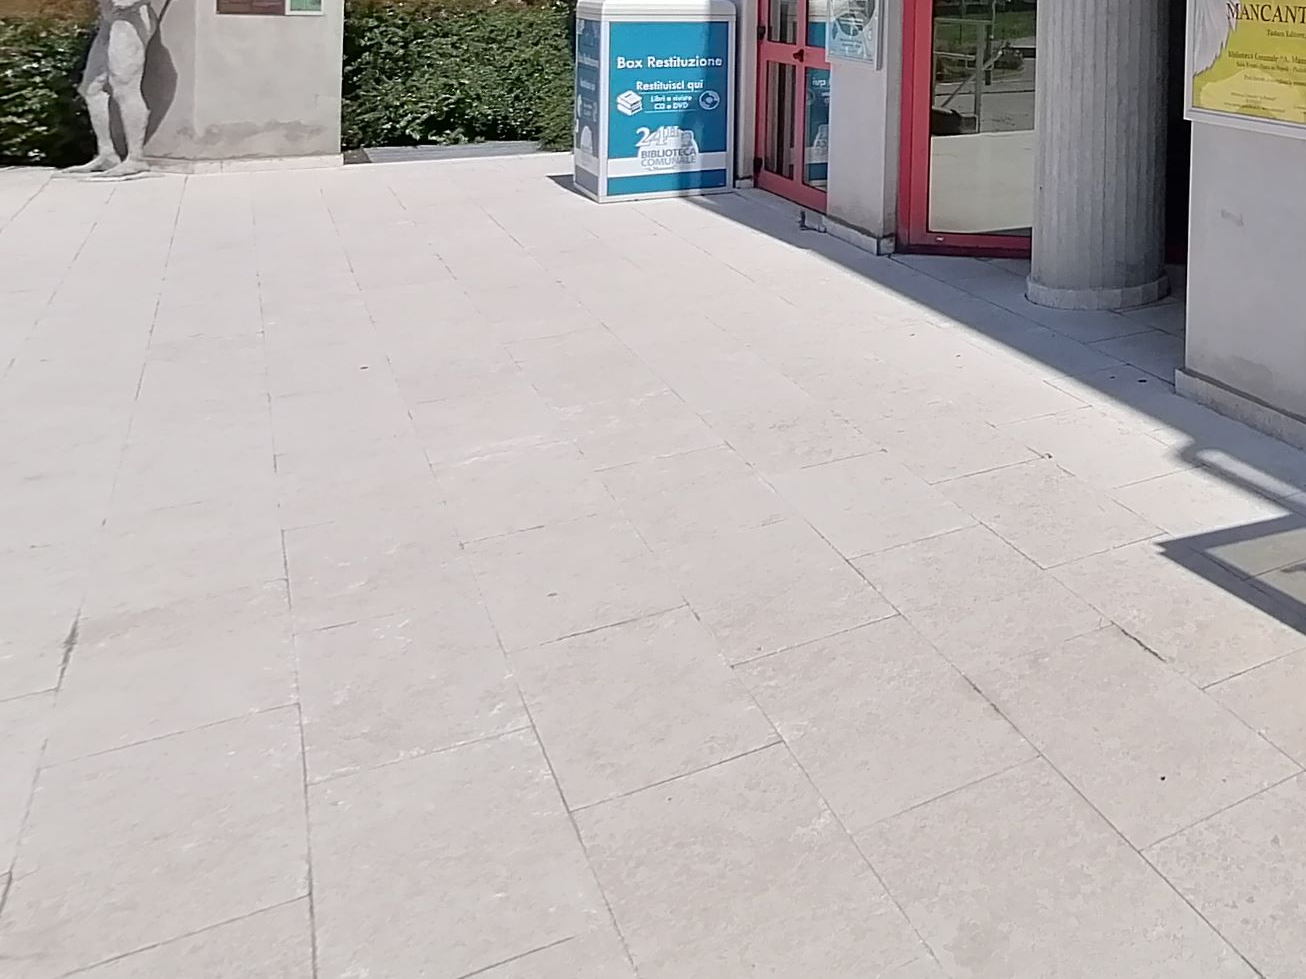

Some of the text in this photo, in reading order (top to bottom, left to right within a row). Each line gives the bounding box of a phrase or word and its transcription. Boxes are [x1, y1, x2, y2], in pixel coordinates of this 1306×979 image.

[616, 55, 723, 69] Box Restituzione
[636, 79, 704, 92] Restituisci qui
[641, 147, 697, 158] BIBLIOTECA
[641, 155, 697, 167] COMUNALE
